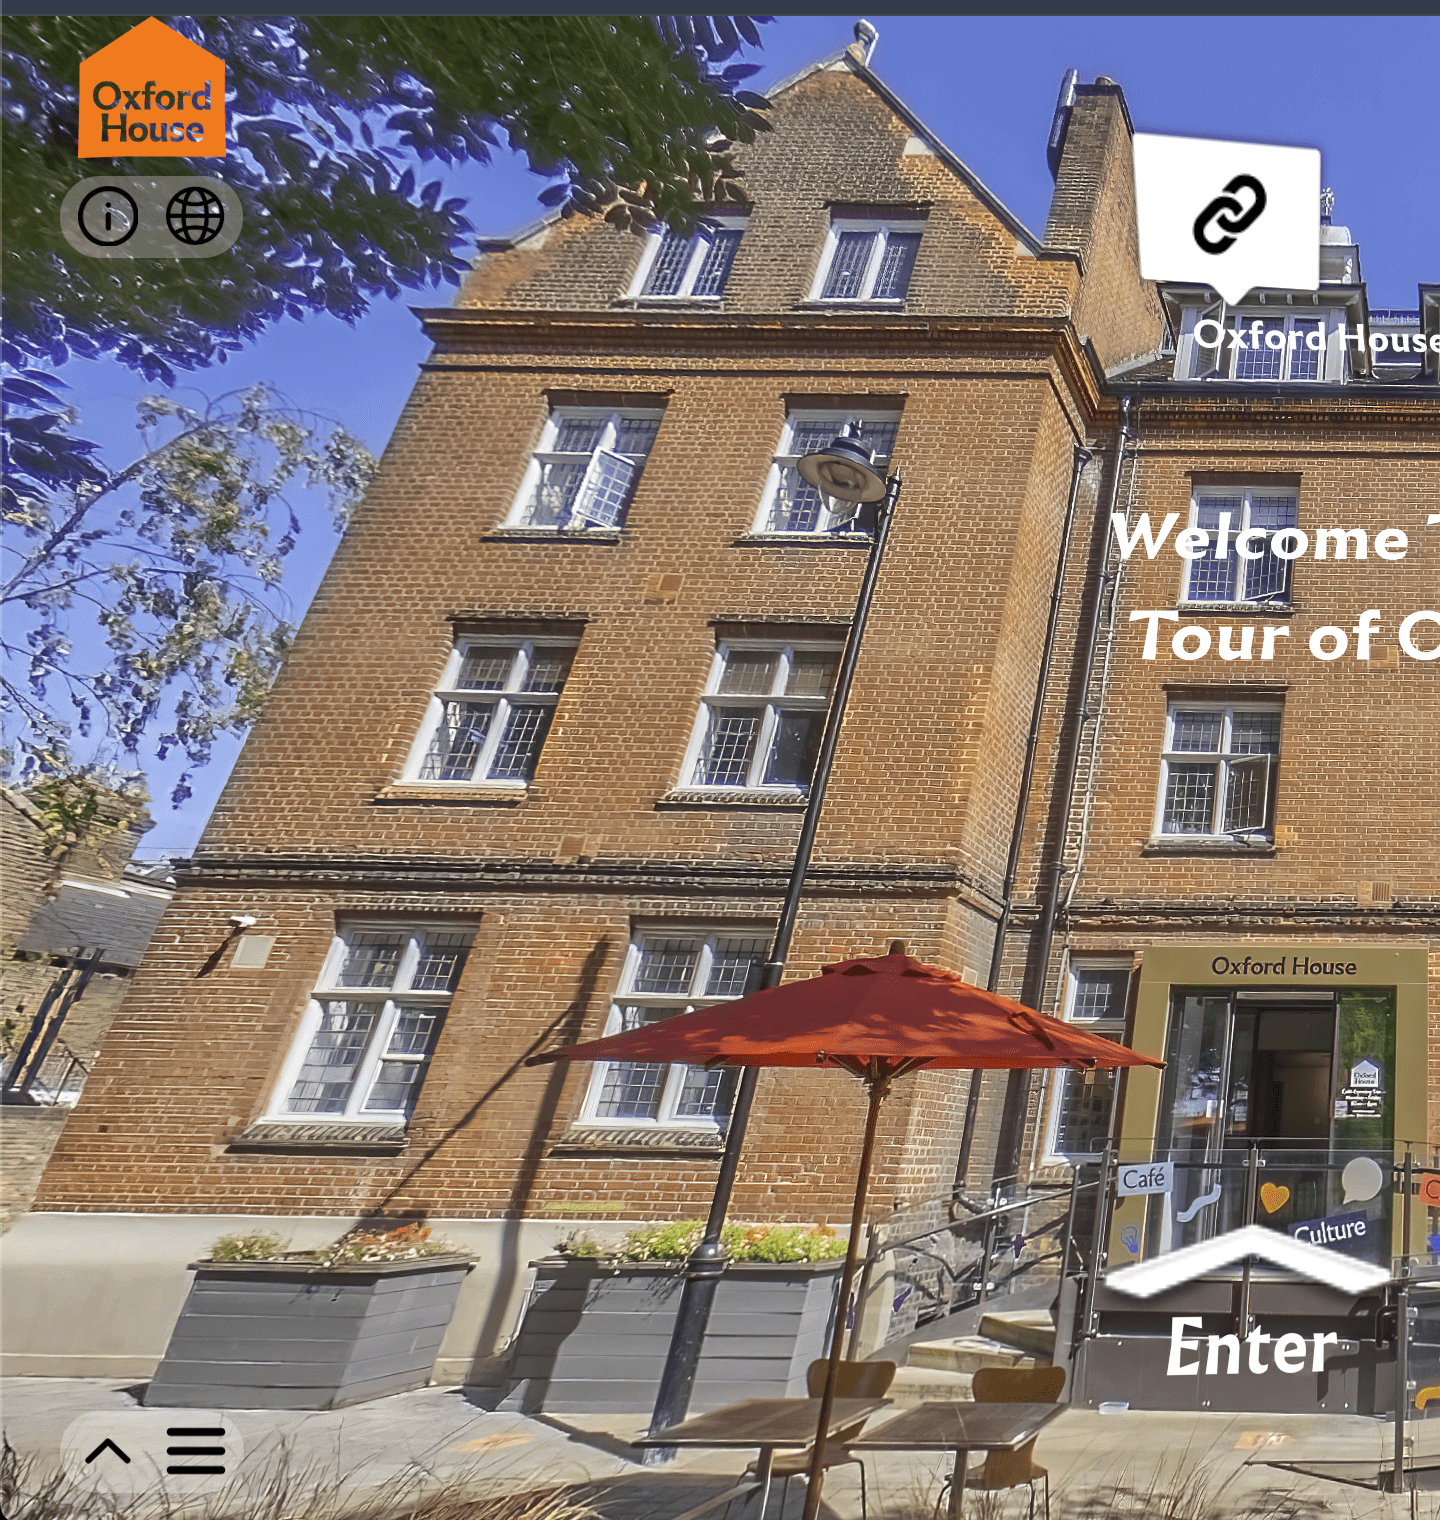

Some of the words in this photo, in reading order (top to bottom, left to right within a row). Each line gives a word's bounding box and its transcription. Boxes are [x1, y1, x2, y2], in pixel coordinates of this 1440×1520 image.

[1211, 955, 1286, 976] Oxford
[1292, 956, 1357, 976] House
[1123, 1166, 1165, 1189] Café
[1294, 1220, 1367, 1246] Culture
